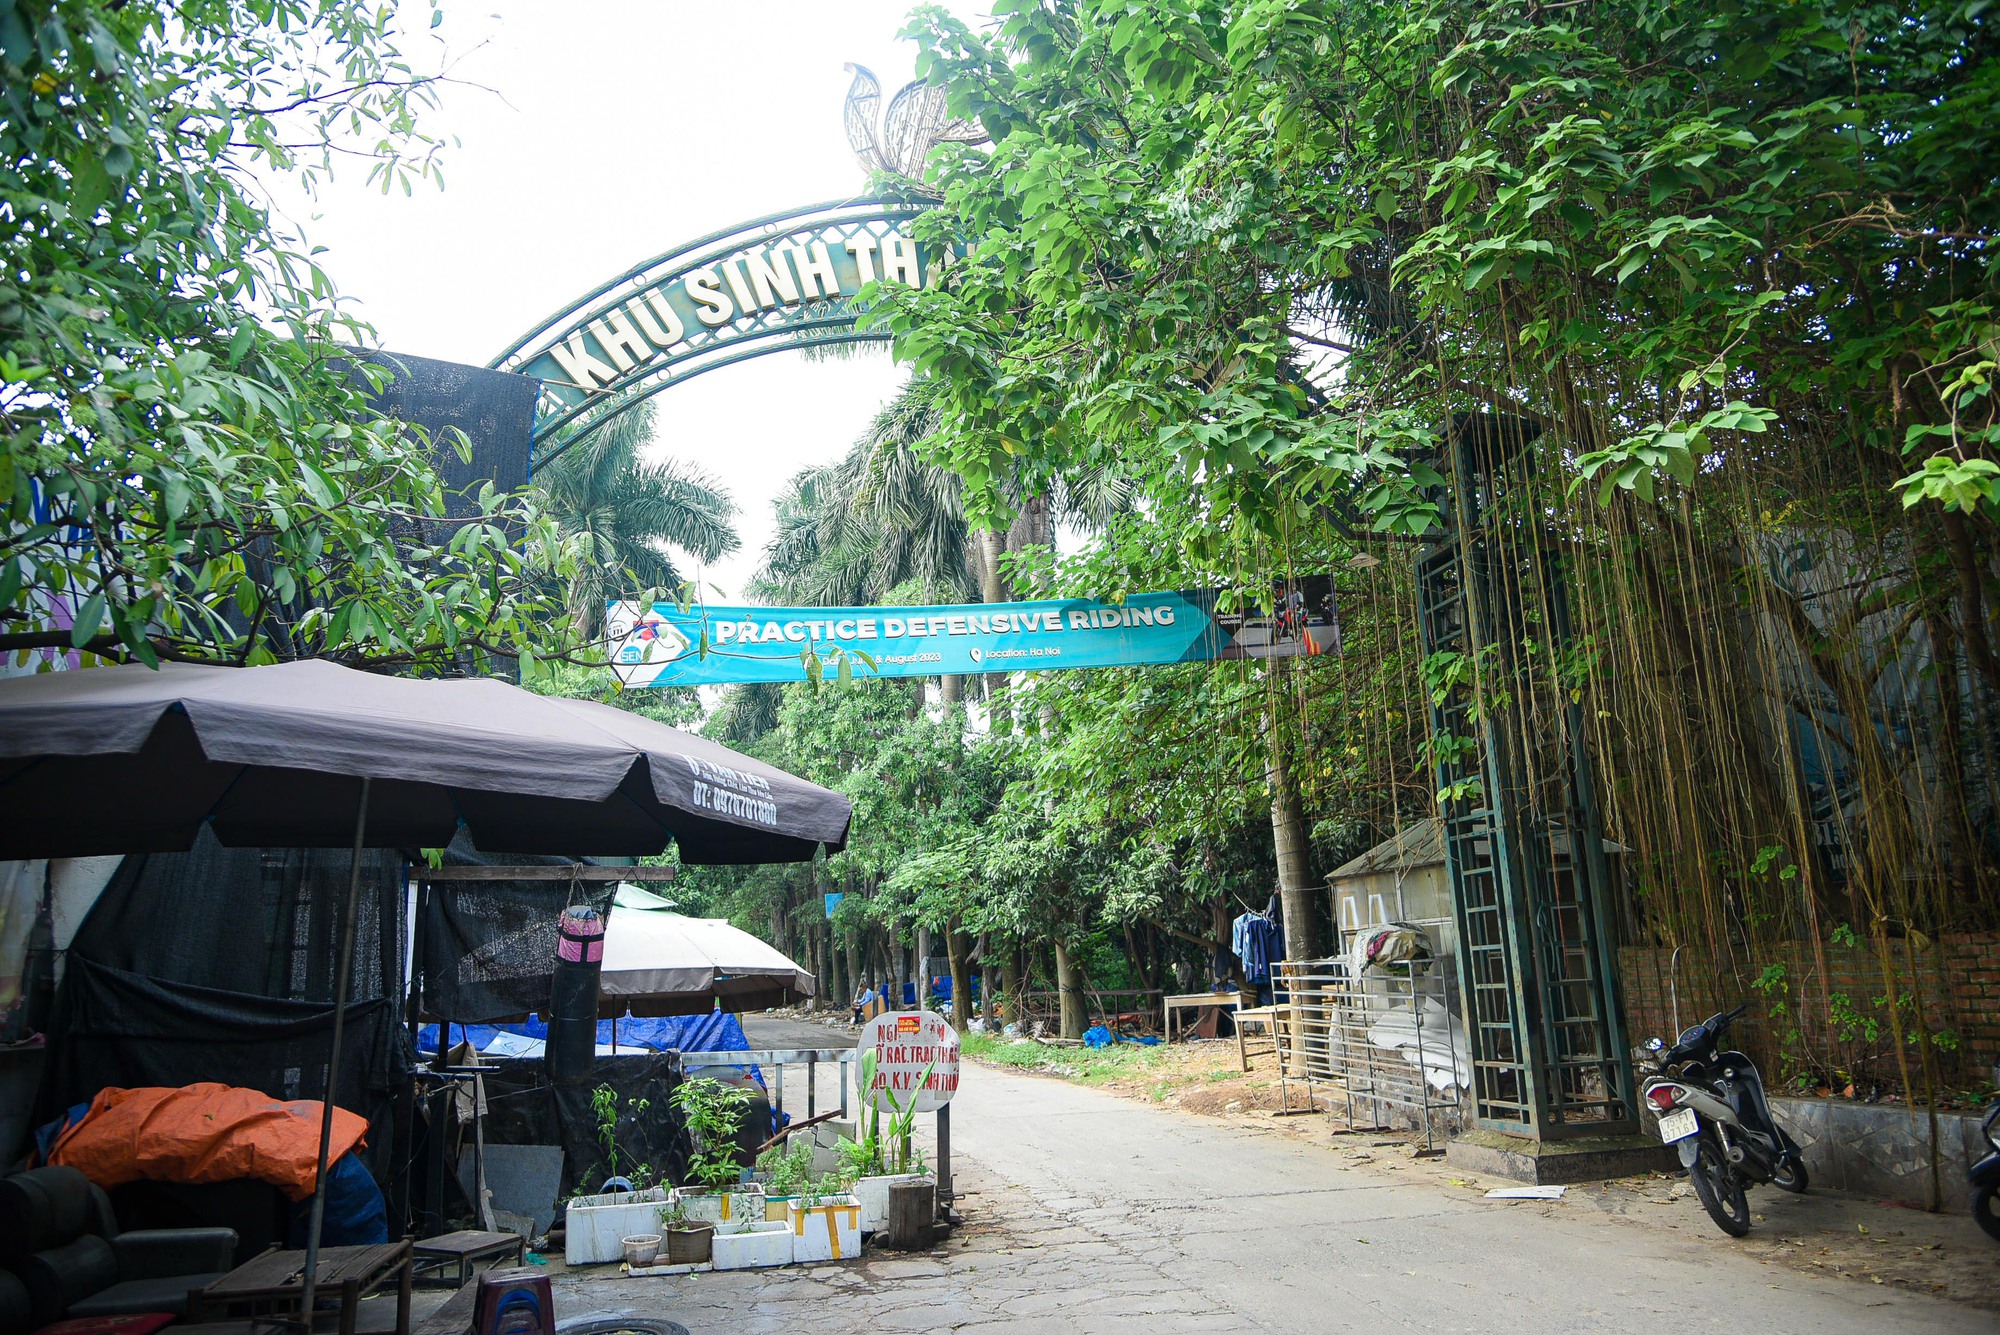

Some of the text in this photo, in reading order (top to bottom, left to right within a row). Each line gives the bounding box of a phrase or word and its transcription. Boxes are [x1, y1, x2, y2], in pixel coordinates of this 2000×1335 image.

[549, 286, 685, 396] KHU
[685, 239, 841, 327] SINH
[715, 606, 1175, 644] PRACTICE DEFENSIVE RIDING
[876, 655, 883, 664] &
[885, 654, 917, 665] August
[920, 652, 941, 663] 2023
[985, 648, 1028, 659] Location:
[1029, 648, 1043, 657] Ha
[1044, 647, 1061, 657] Noi
